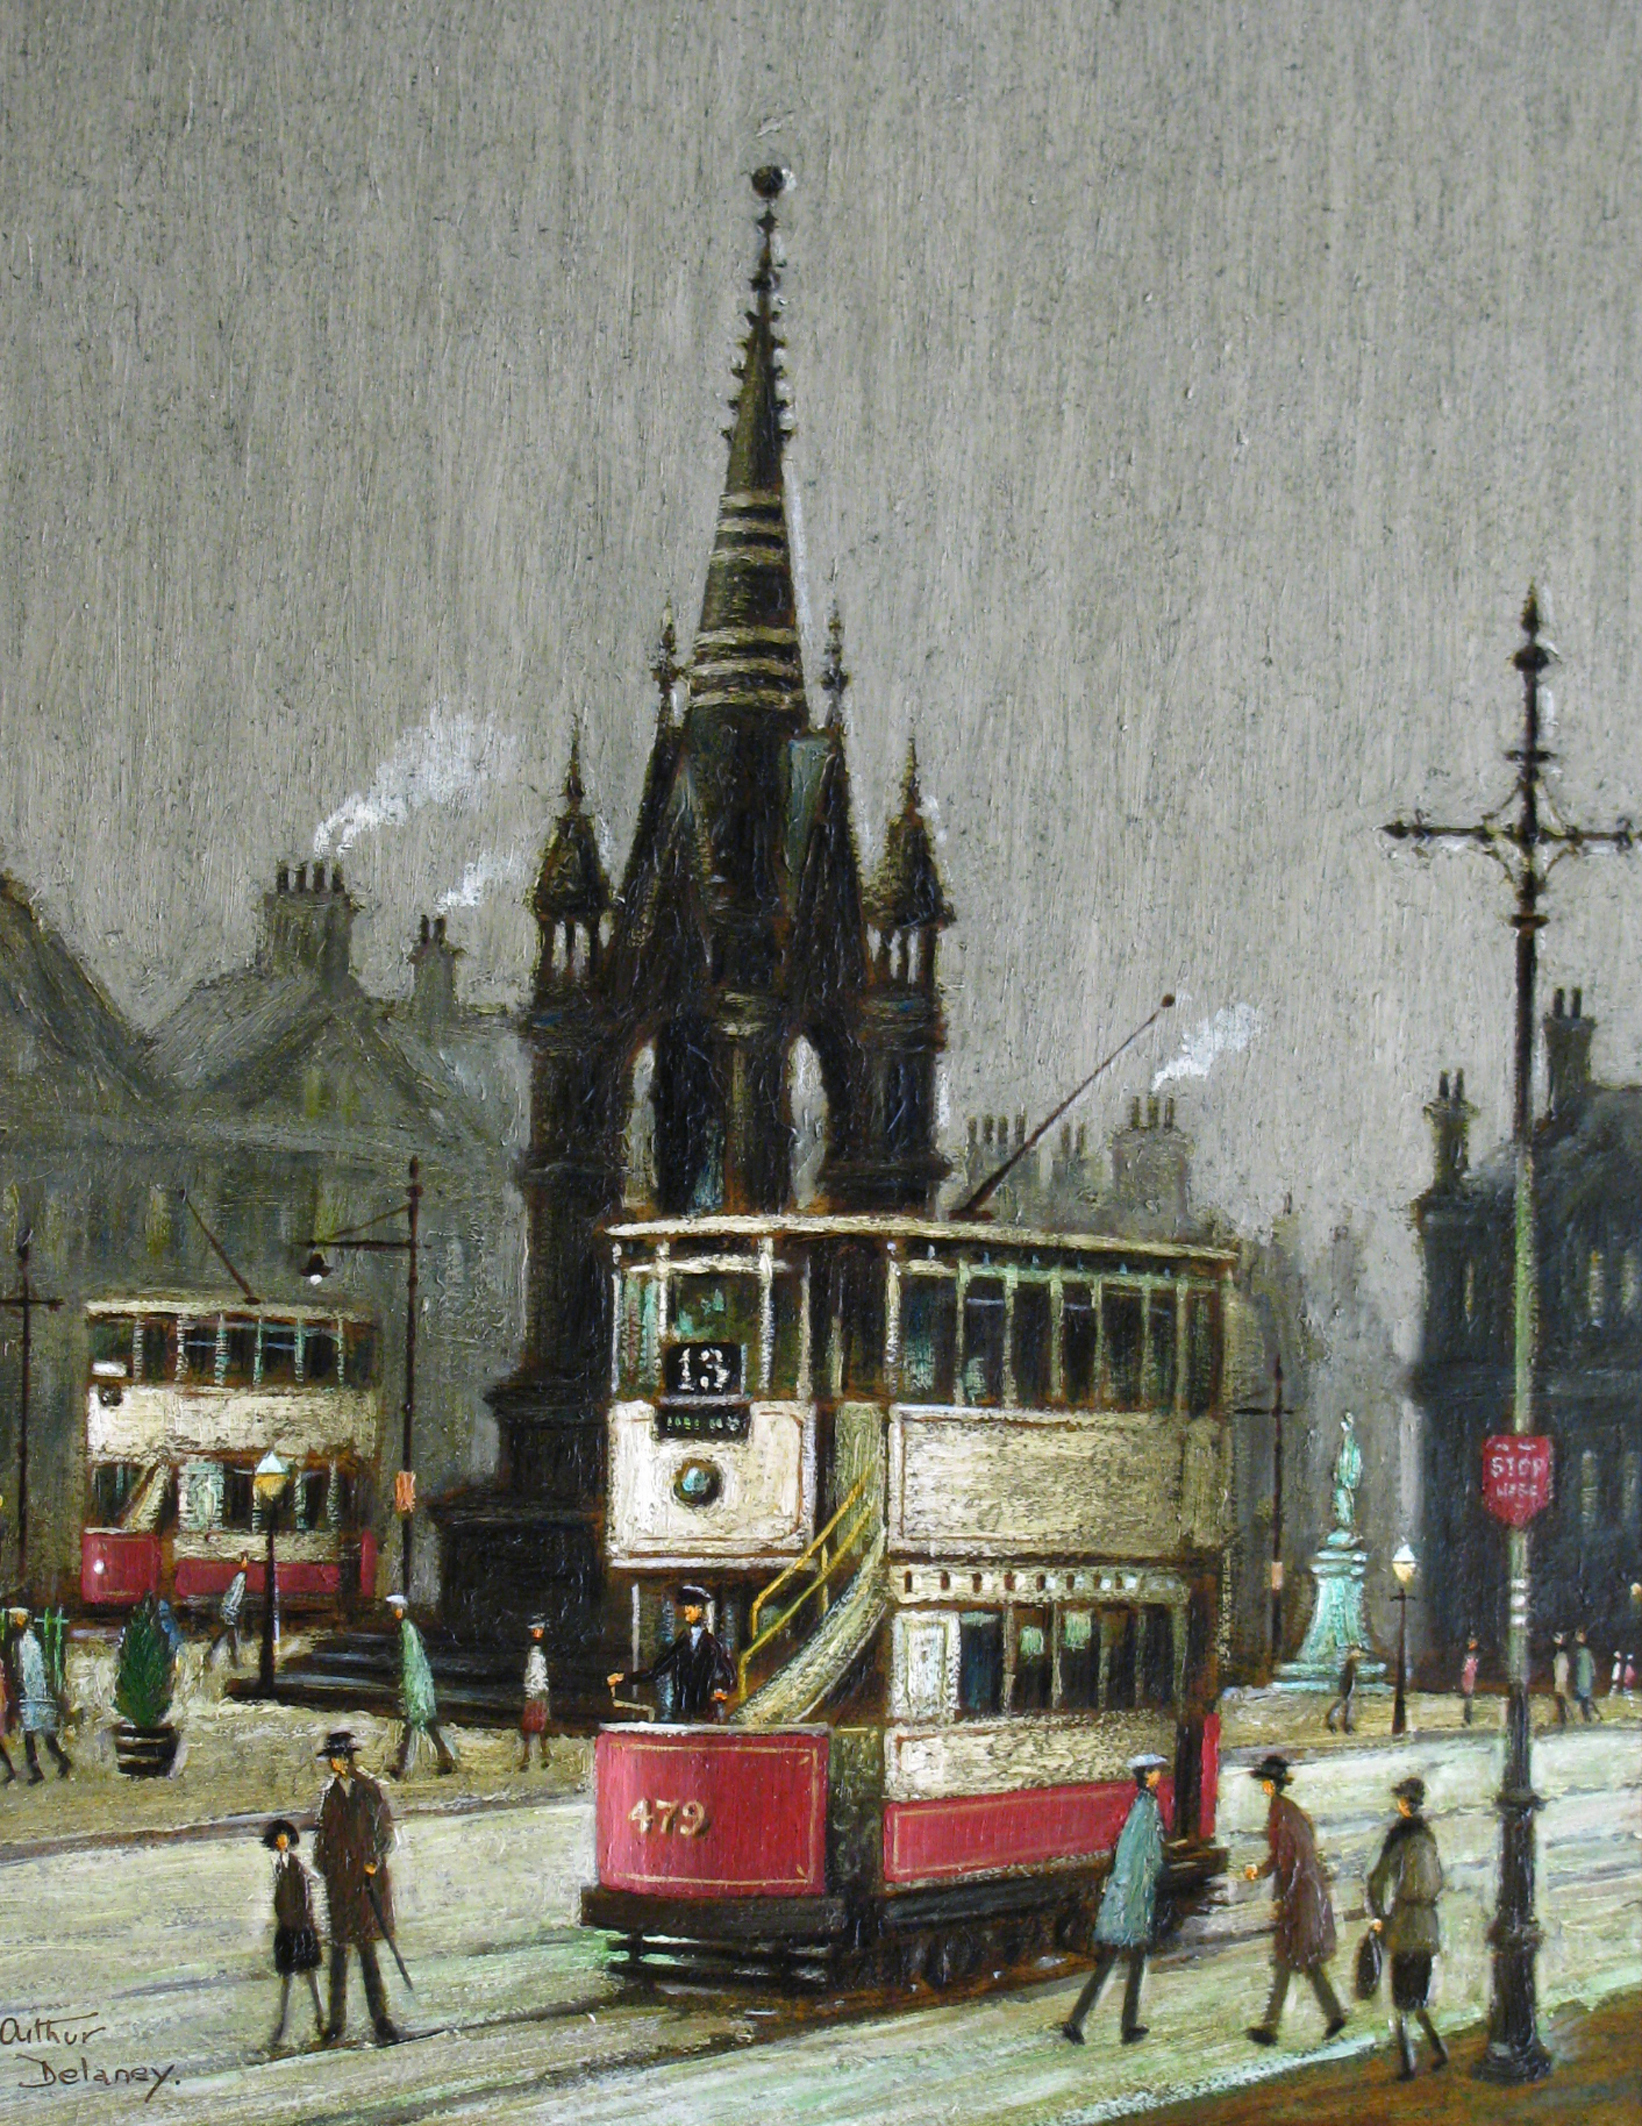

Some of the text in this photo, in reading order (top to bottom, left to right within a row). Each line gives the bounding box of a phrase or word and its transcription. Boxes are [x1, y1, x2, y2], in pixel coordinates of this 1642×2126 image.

[678, 1347, 730, 1392] 13
[1490, 1456, 1544, 1478] STOP
[627, 1797, 705, 1836] 479
